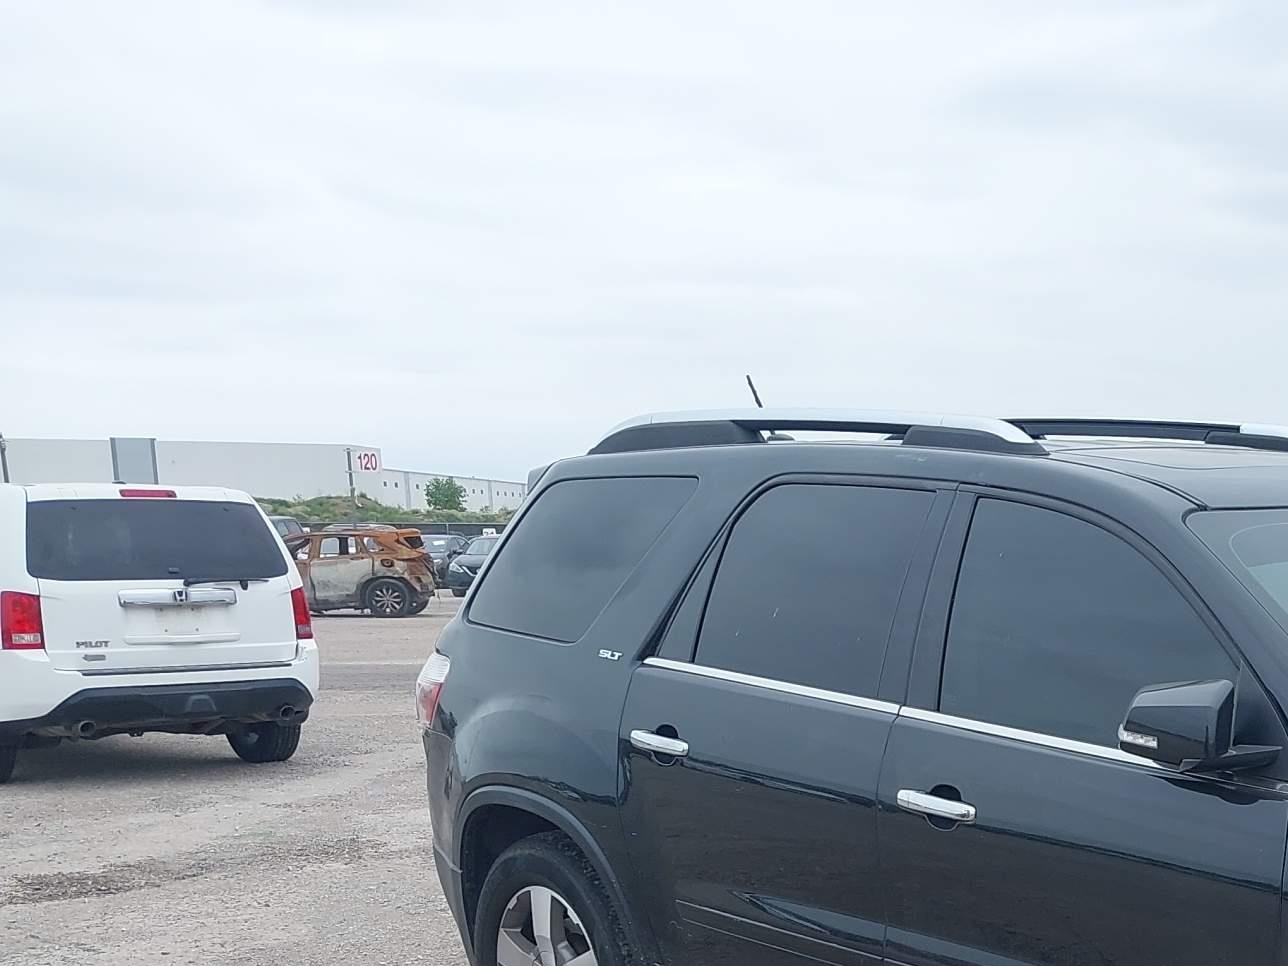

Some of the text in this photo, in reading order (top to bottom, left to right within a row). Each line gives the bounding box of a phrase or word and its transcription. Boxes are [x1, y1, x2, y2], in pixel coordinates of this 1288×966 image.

[357, 452, 378, 471] 120
[75, 640, 111, 649] PILOT
[598, 649, 623, 660] SLT
